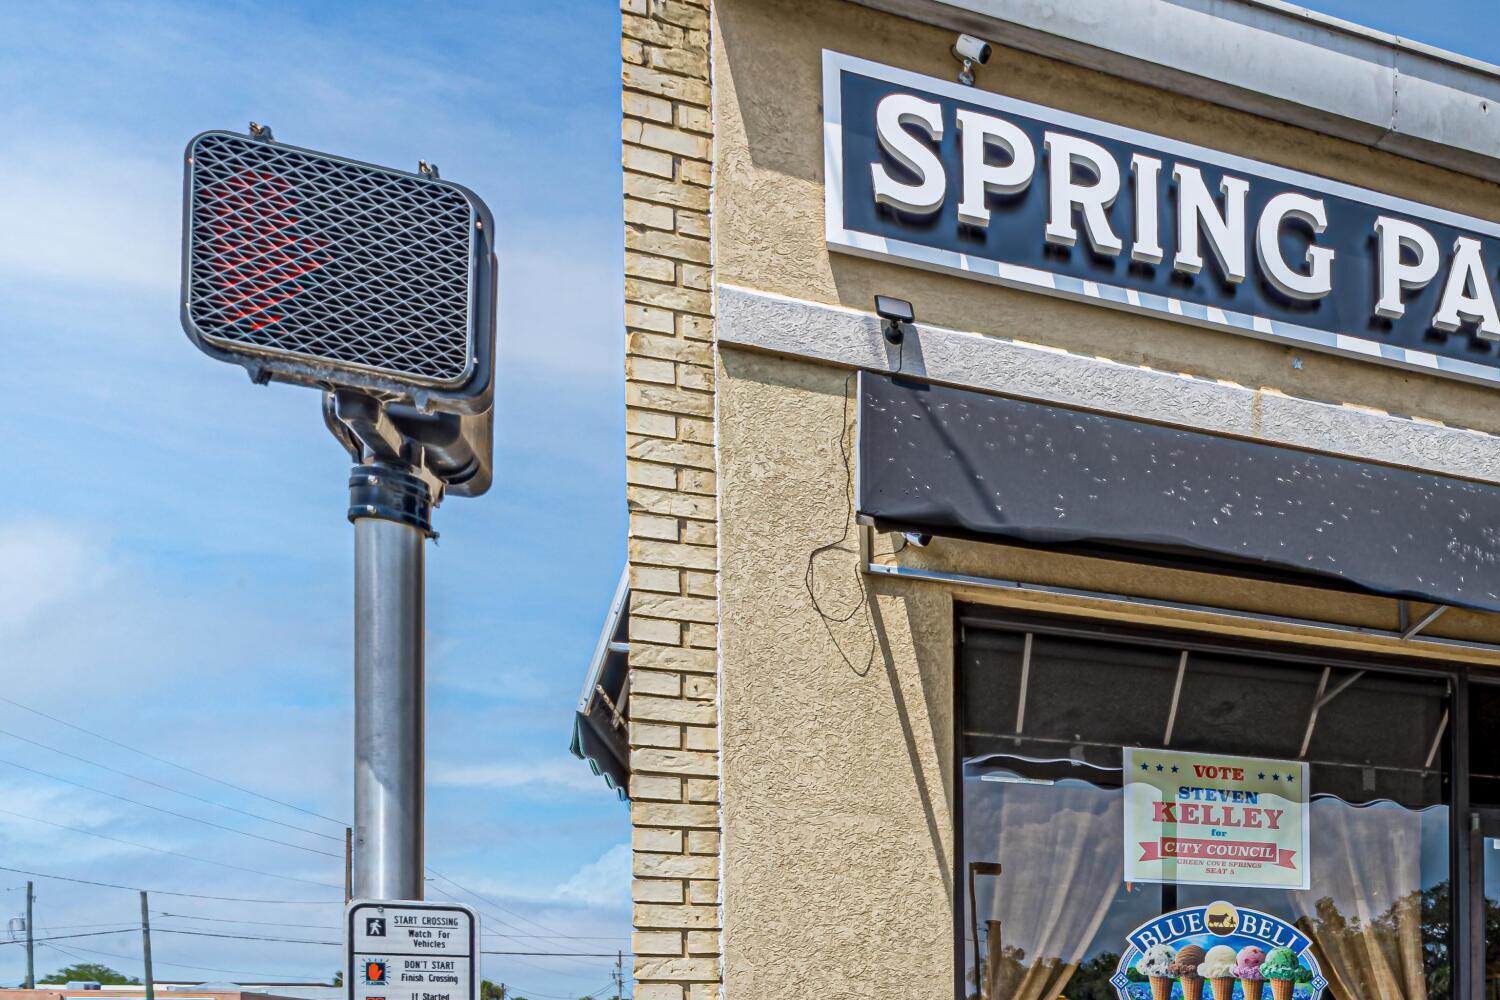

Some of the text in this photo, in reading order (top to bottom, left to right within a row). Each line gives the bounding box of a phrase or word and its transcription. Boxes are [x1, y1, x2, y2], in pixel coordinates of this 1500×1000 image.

[870, 92, 1335, 300] SPRING
[1193, 764, 1245, 781] VOTE
[1178, 786, 1259, 804] STEVEN
[1152, 801, 1284, 829] KELLEY
[1211, 829, 1227, 837] for
[1164, 841, 1275, 858] CITY COUNCIL
[1228, 861, 1262, 869] SPRINGS
[394, 916, 458, 926] START CROSSING
[408, 930, 450, 939] Watch For
[1137, 913, 1203, 949] BLUE
[414, 939, 446, 948] Vehicles
[404, 960, 455, 970] DON'T START
[401, 973, 458, 985] Finish Crossing
[423, 993, 450, 1000] Started
